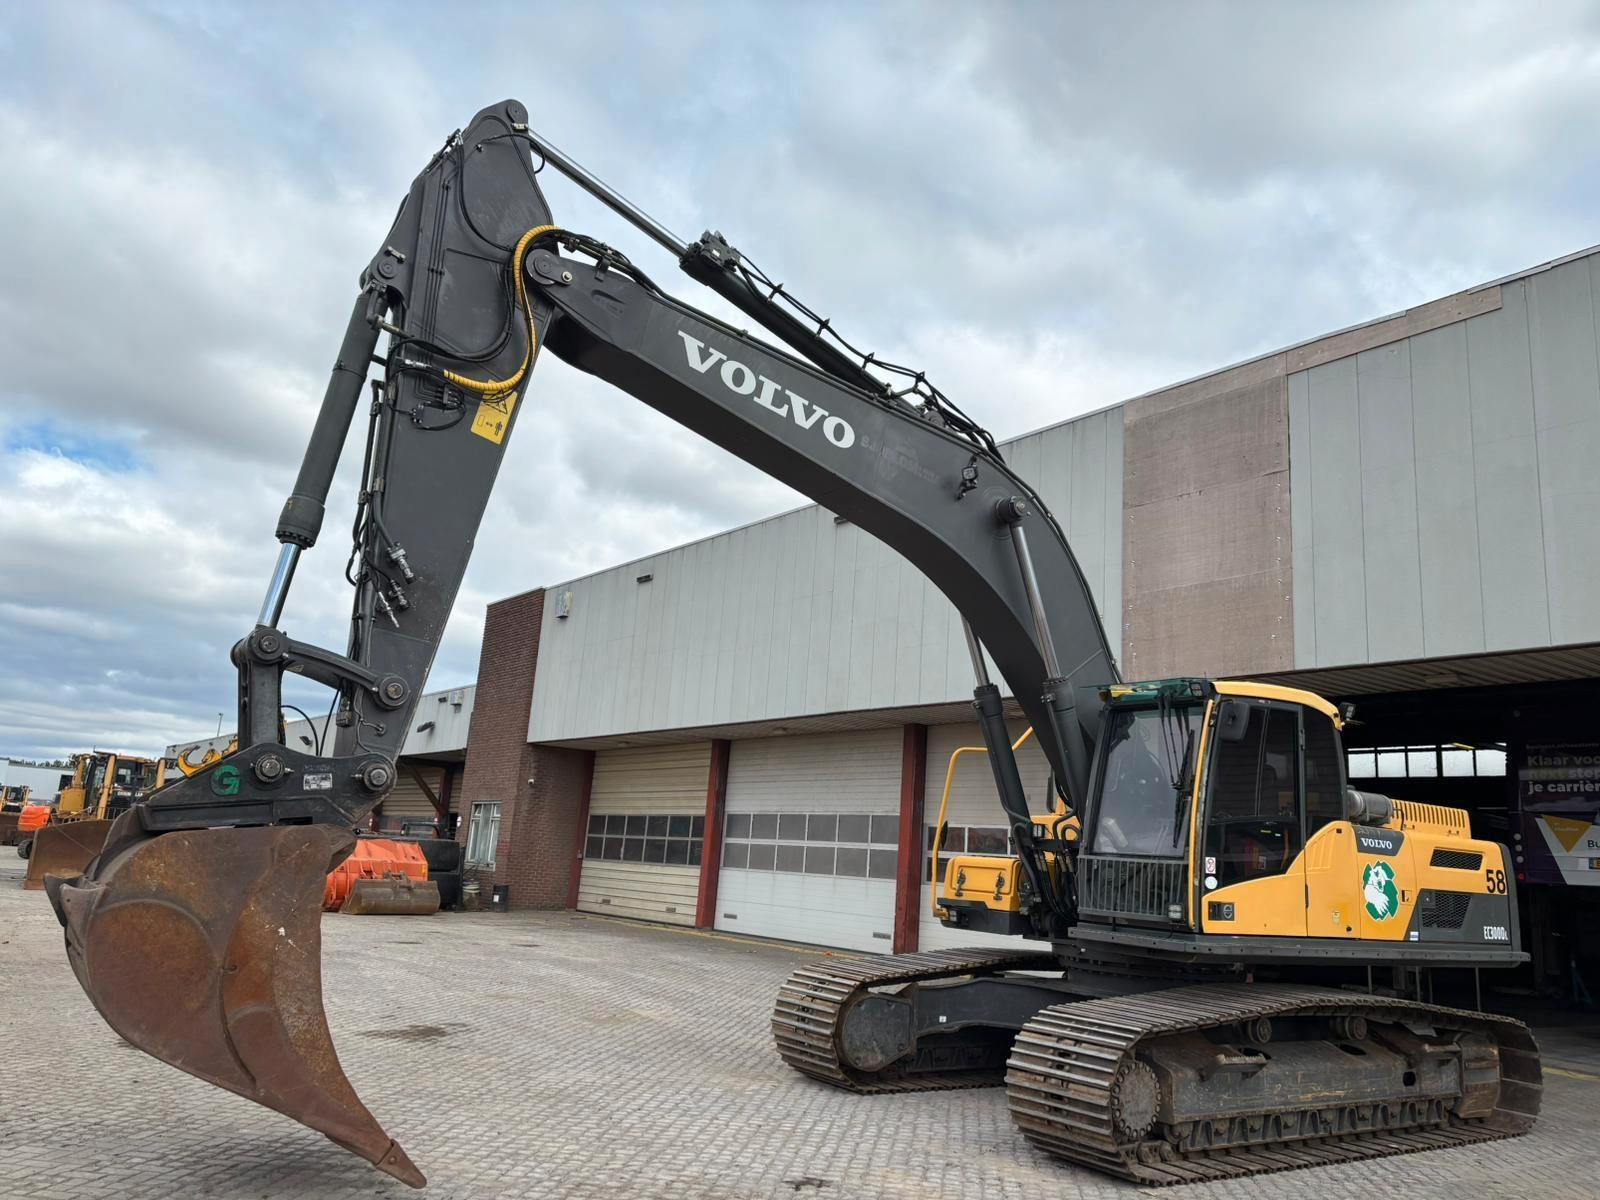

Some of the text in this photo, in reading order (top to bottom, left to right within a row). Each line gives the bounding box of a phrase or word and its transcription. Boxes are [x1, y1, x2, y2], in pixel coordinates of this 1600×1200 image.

[678, 330, 856, 449] VOLVO
[1527, 755, 1568, 767] Klaar
[210, 764, 240, 796] G
[1528, 781, 1545, 796] je
[1361, 837, 1393, 850] VOLVO
[1486, 869, 1506, 894] 58
